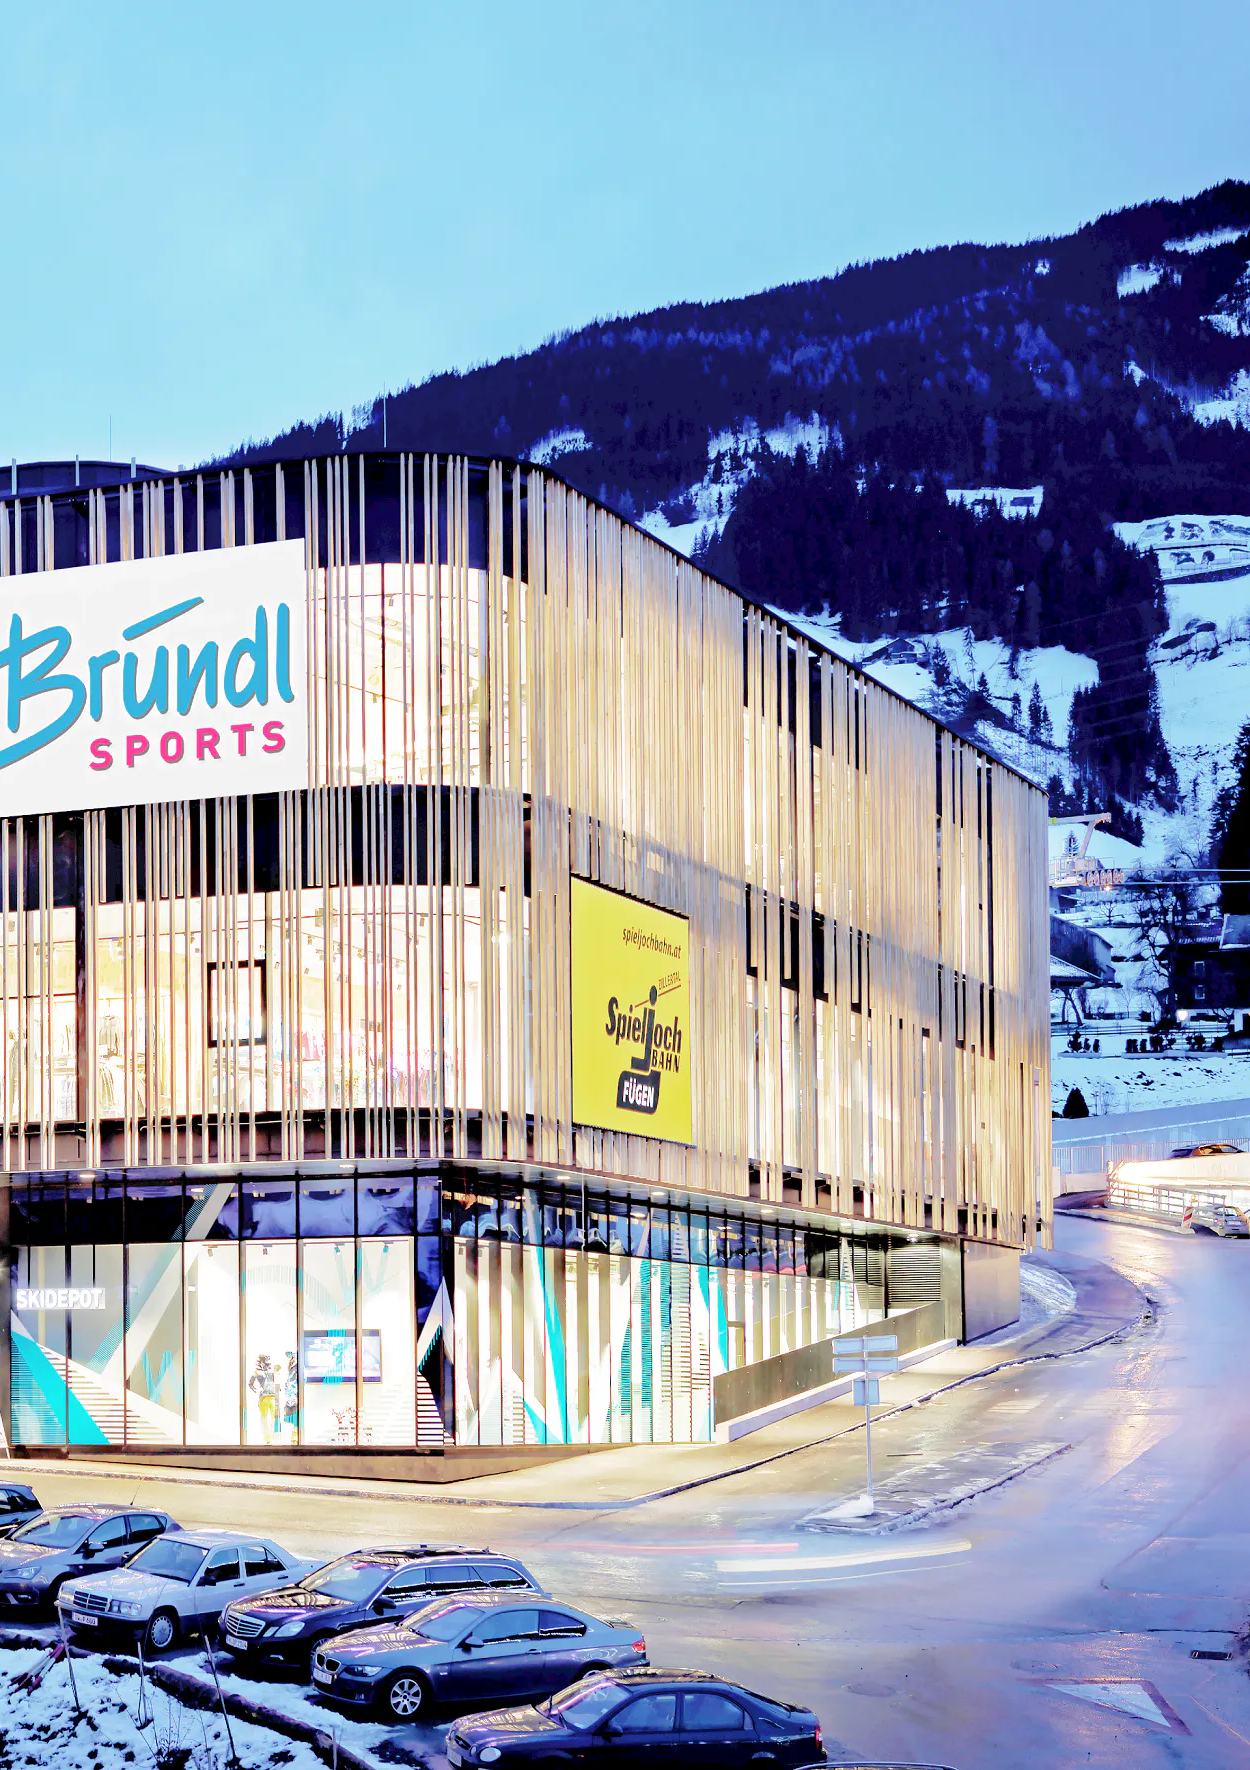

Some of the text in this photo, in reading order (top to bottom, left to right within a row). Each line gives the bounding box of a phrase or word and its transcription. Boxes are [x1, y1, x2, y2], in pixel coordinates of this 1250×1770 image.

[89, 720, 286, 771] SPORTS
[622, 926, 681, 959] spieljochbahn.at
[658, 971, 681, 990] ZILLERTAL
[651, 1049, 680, 1073] BAHN
[622, 1078, 655, 1108] FÜGEN
[16, 1288, 103, 1310] SKIDEPOT
